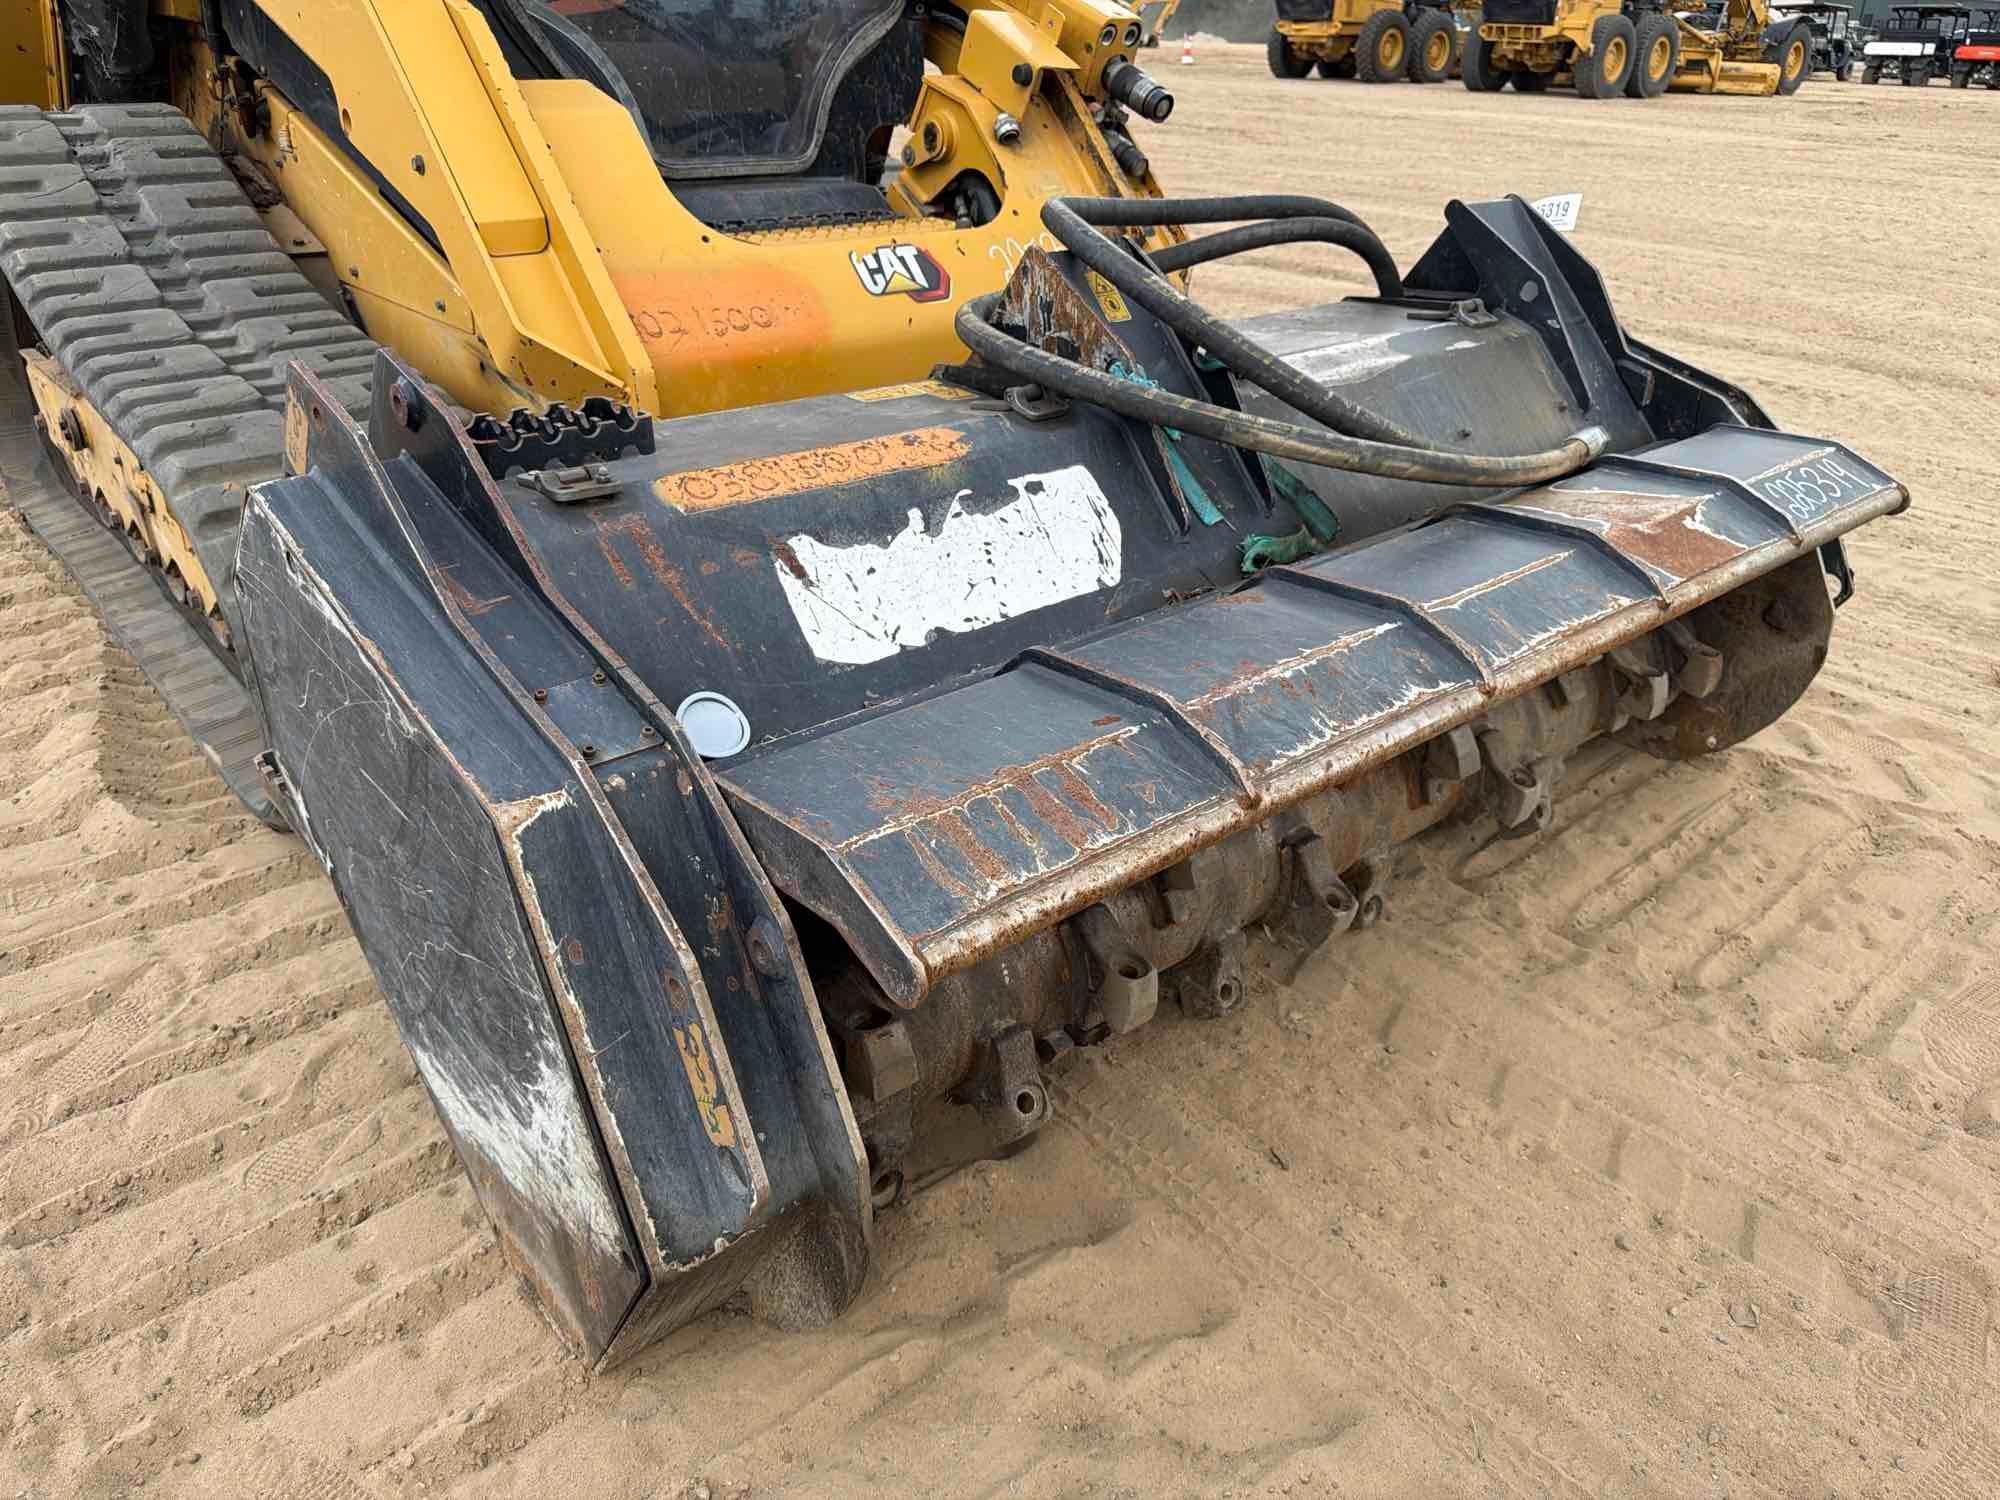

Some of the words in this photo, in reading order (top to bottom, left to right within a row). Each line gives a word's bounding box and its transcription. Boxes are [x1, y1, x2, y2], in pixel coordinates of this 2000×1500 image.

[1536, 200, 1571, 218] 5319
[848, 244, 930, 295] CAT
[1763, 457, 1873, 520] 225319
